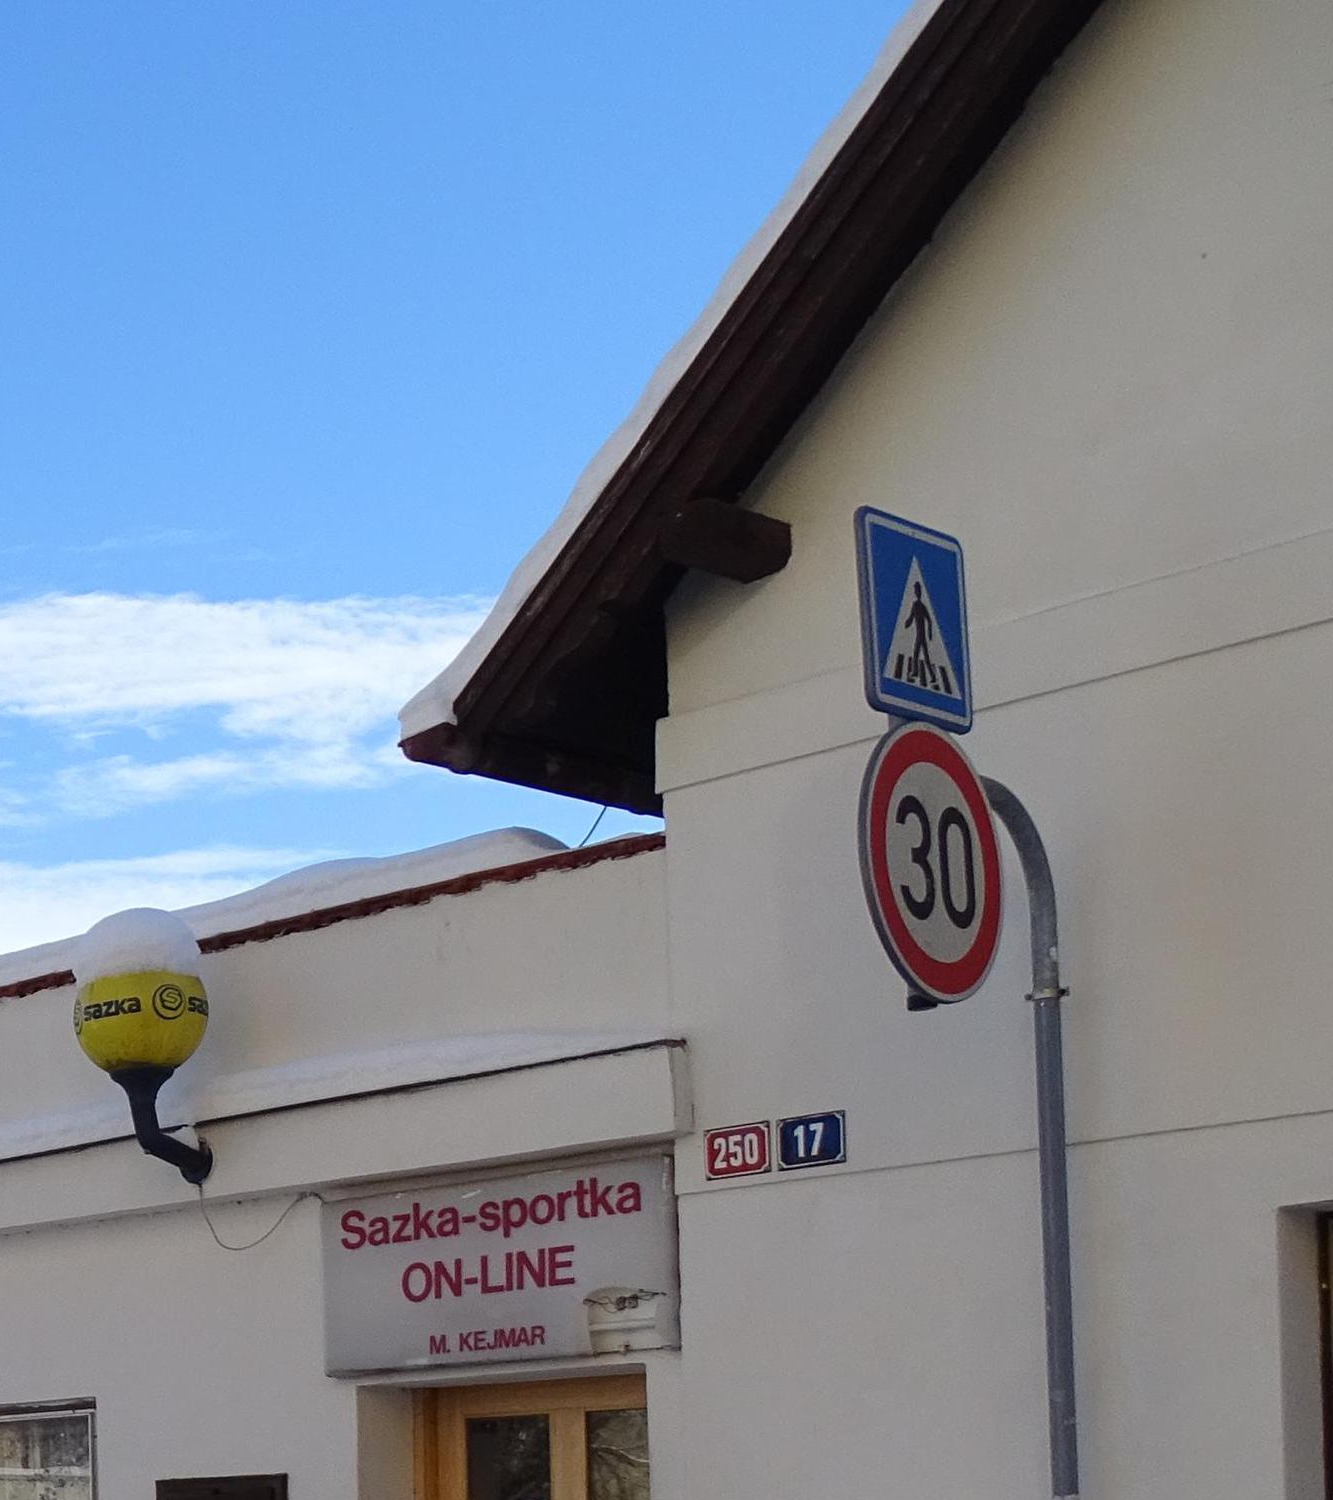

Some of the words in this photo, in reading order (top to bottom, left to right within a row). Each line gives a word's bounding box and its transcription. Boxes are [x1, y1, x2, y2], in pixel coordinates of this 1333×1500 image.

[895, 794, 976, 930] 30
[713, 1132, 759, 1169] 250
[793, 1122, 824, 1158] 17
[340, 1177, 642, 1250] Sazka-sportka
[401, 1244, 575, 1303] ON-LINE
[429, 1334, 451, 1355] M.
[459, 1325, 546, 1352] KEJMAR
